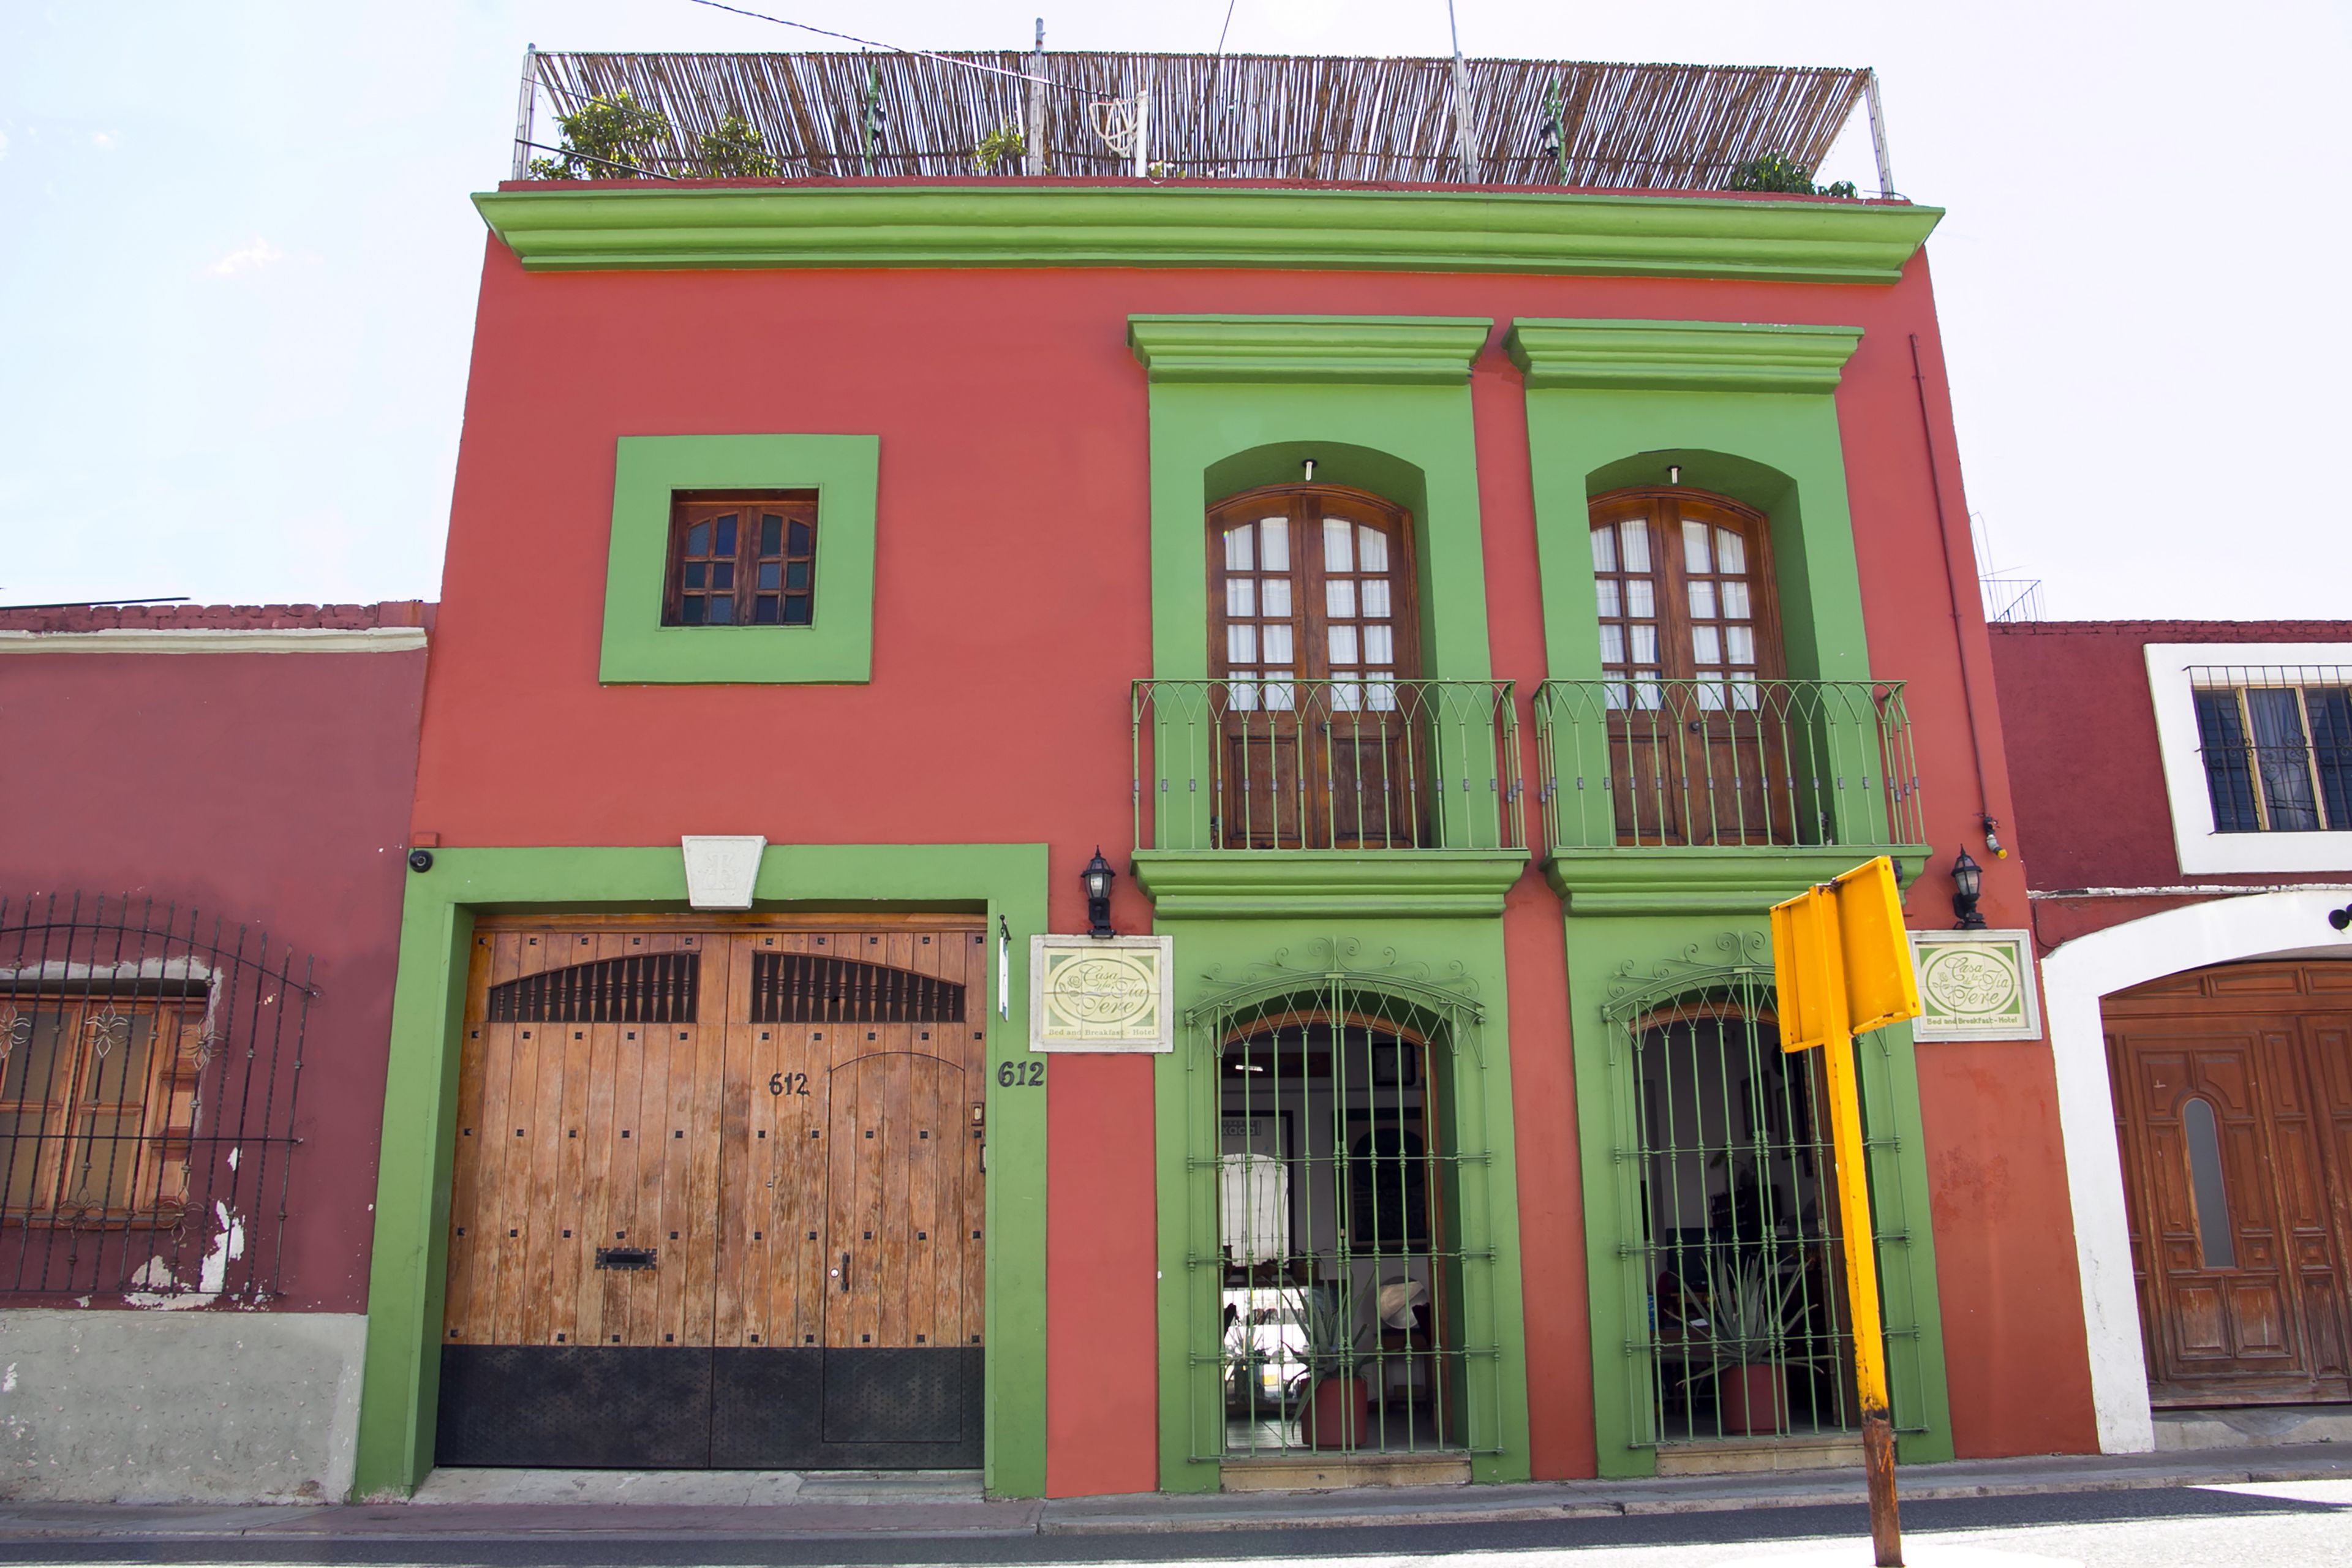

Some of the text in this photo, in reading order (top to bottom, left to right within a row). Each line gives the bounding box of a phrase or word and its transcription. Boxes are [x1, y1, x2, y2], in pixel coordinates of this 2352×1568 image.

[1079, 963, 1118, 987] Casa
[1945, 957, 1983, 981] Casa
[1076, 991, 1134, 1017] Tere
[1948, 985, 1999, 1007] Tere
[769, 1072, 810, 1097] 612
[997, 1060, 1044, 1088] 612
